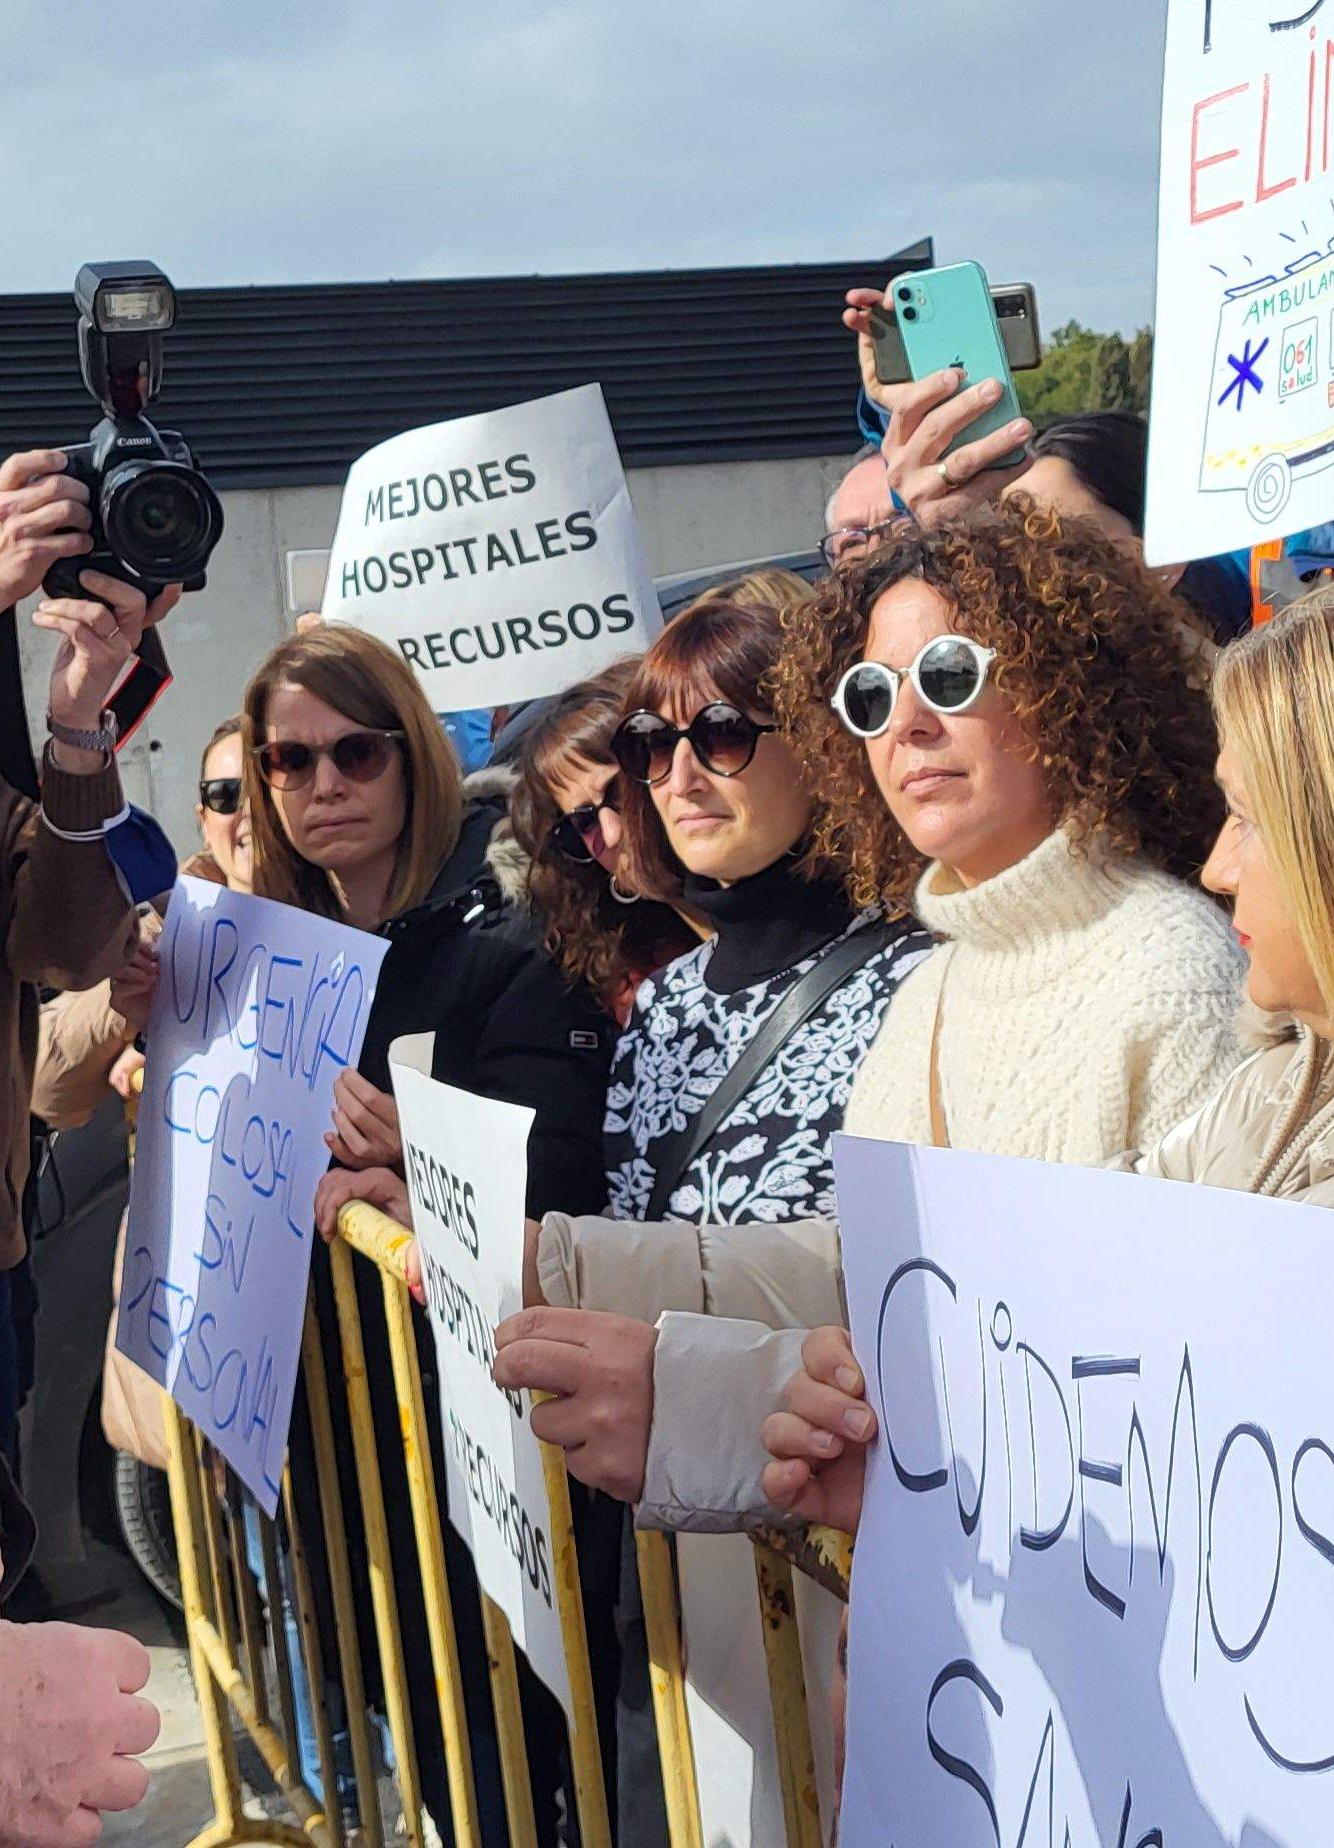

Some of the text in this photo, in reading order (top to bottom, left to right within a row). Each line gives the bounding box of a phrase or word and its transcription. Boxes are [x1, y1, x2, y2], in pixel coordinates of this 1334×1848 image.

[1281, 366, 1313, 393] salud
[1284, 335, 1313, 374] 061
[117, 436, 152, 447] Canon
[364, 453, 537, 527] MEJORES
[341, 510, 598, 599] HOSPITALES
[397, 593, 635, 671] RECURSOS
[164, 1070, 305, 1240] COLOSAL
[421, 1243, 528, 1420] HOSPITAL
[127, 1246, 280, 1497] PERSONAL
